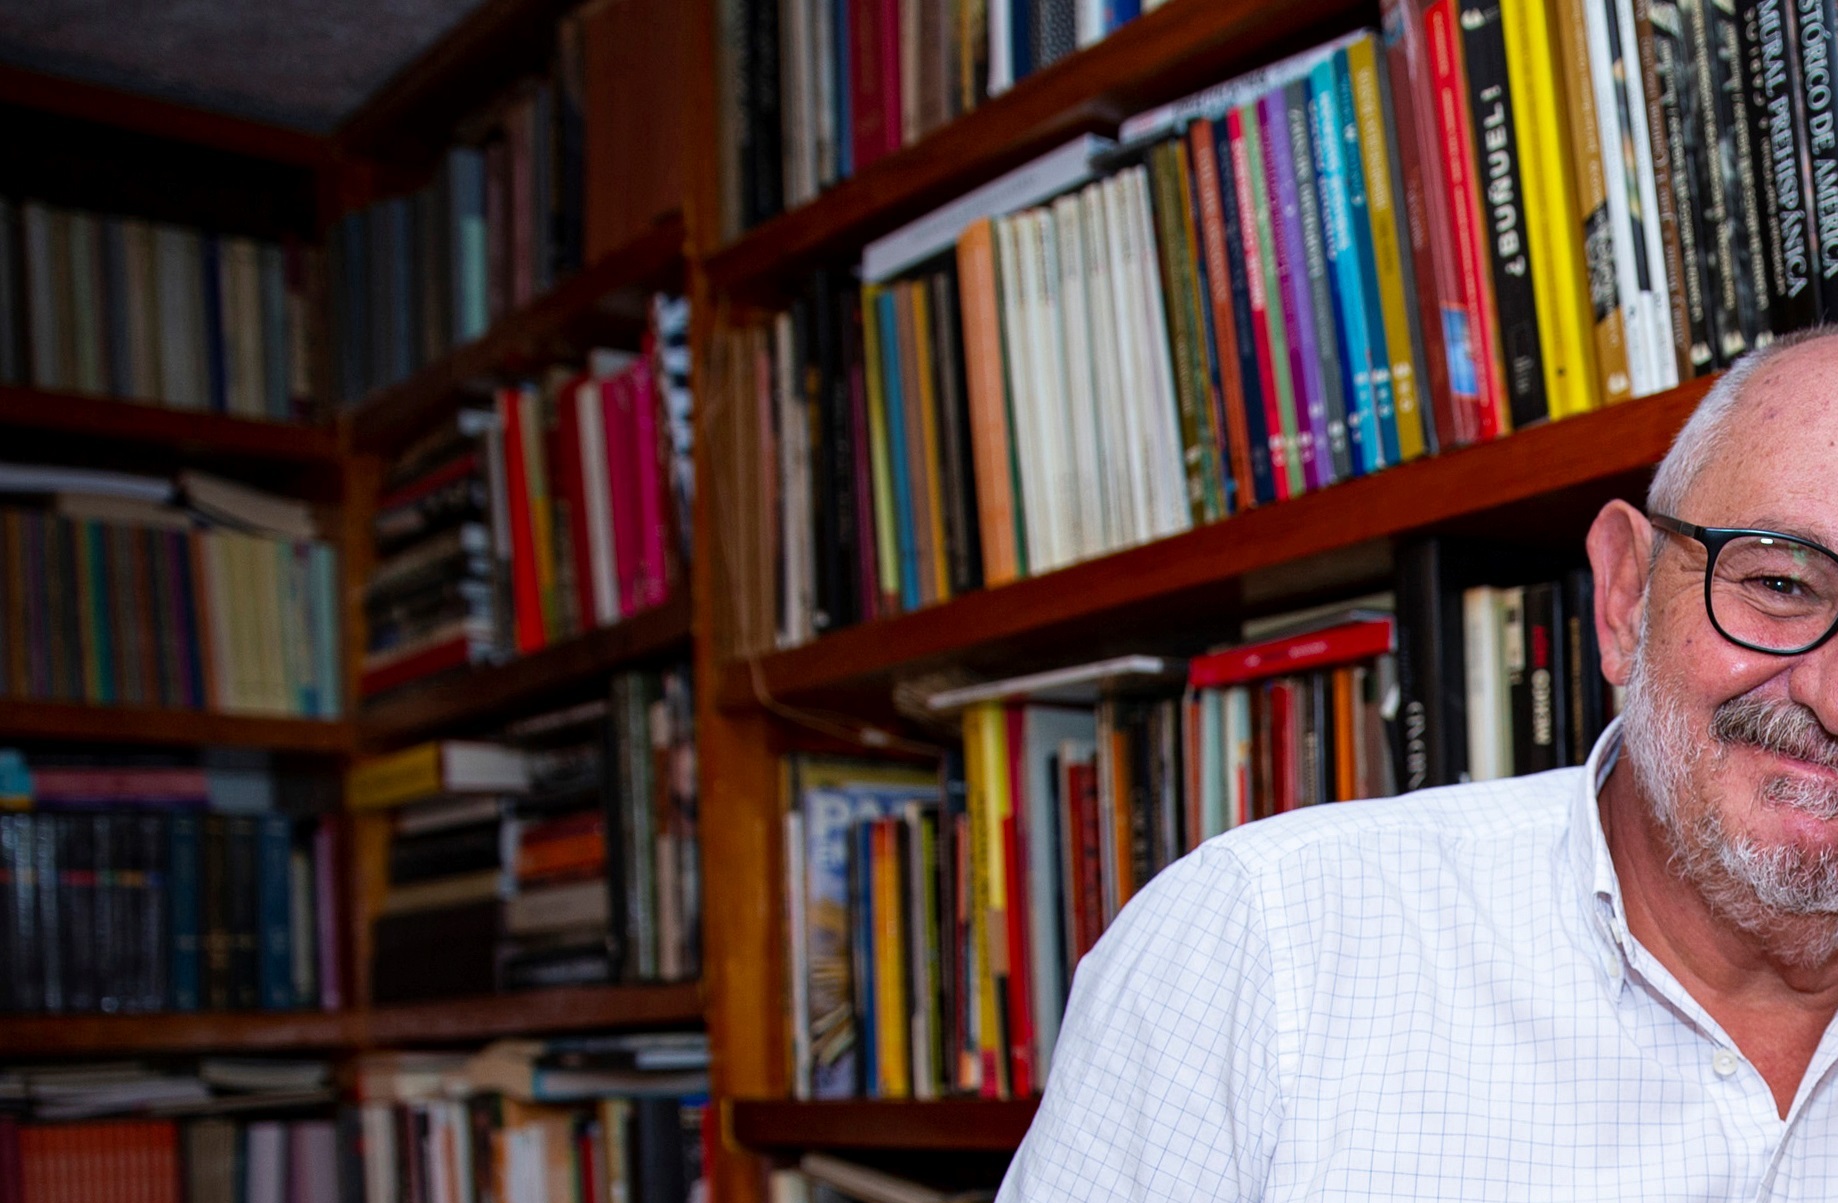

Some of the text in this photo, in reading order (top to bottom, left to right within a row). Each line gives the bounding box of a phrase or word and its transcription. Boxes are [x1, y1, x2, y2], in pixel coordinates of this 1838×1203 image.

[1757, 0, 1787, 98] MURAL
[1809, 110, 1835, 156] DE
[1767, 95, 1808, 299] PREHISPÁNICA
